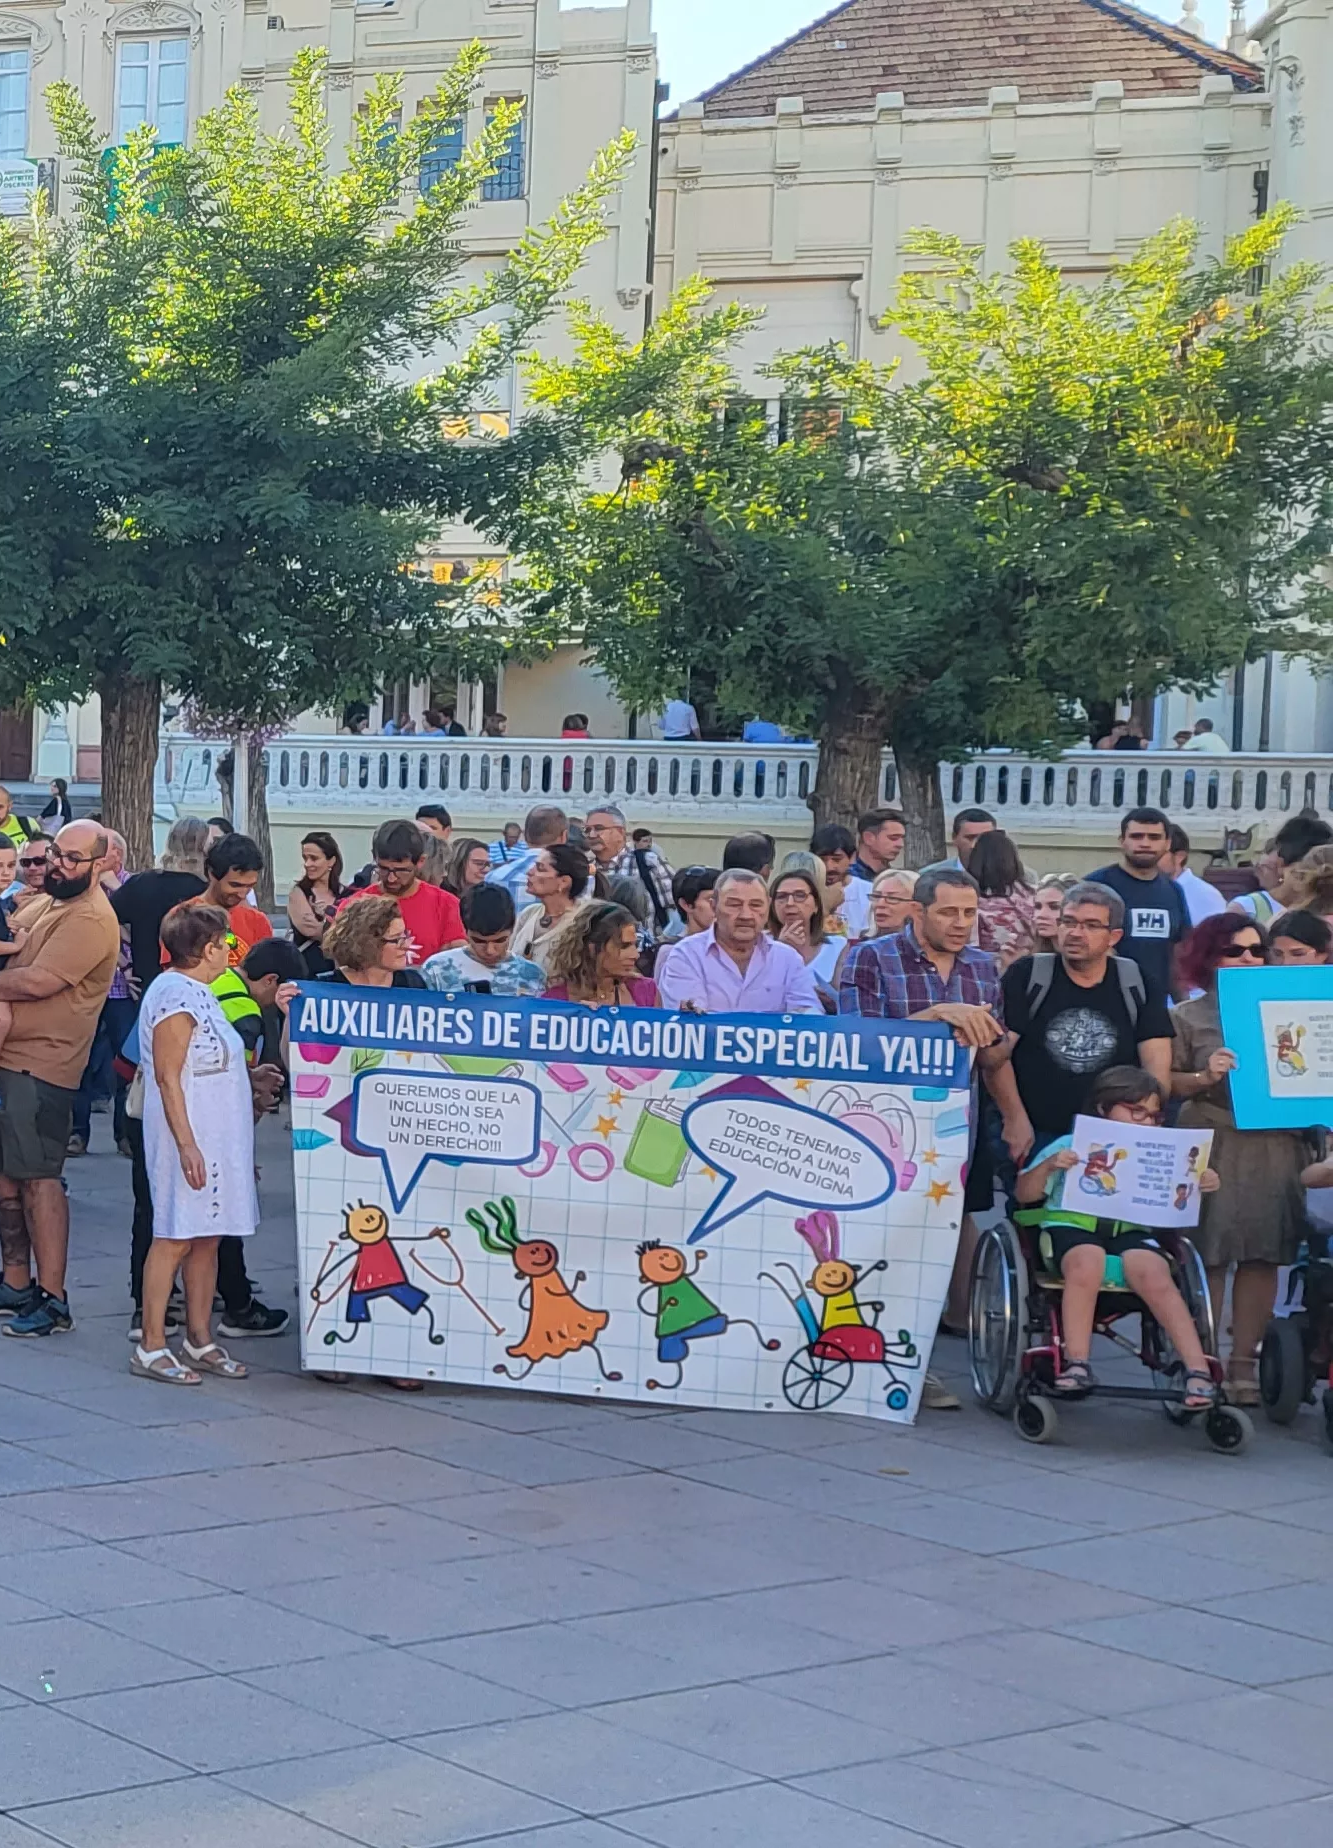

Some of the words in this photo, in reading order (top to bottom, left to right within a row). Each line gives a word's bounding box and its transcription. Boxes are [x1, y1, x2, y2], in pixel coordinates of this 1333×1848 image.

[1137, 912, 1166, 929] HH
[298, 996, 474, 1045] AUXILIARES
[482, 1010, 522, 1049] DE
[529, 1013, 706, 1061] EDUCACIÓN
[714, 1024, 869, 1072] ESPECIAL
[878, 1035, 955, 1077] YA!!!
[374, 1082, 461, 1100] QUEREMOS
[465, 1089, 498, 1103] QUE
[501, 1092, 521, 1105] LA
[389, 1099, 470, 1117] INCLUSIÓN
[473, 1107, 504, 1120] SEA
[390, 1115, 412, 1129] UN
[416, 1118, 474, 1136] HECHO,
[478, 1123, 501, 1136] NO
[726, 1108, 782, 1137] TODOS
[785, 1128, 862, 1164] TENEMOS
[388, 1131, 410, 1144] UN
[414, 1133, 502, 1152] DERECHO!!!
[723, 1125, 802, 1161] DERECHO
[802, 1154, 814, 1166] A
[817, 1157, 850, 1180] UNA
[708, 1138, 802, 1179] EDUCACIÓN
[804, 1171, 854, 1199] DIGNA
